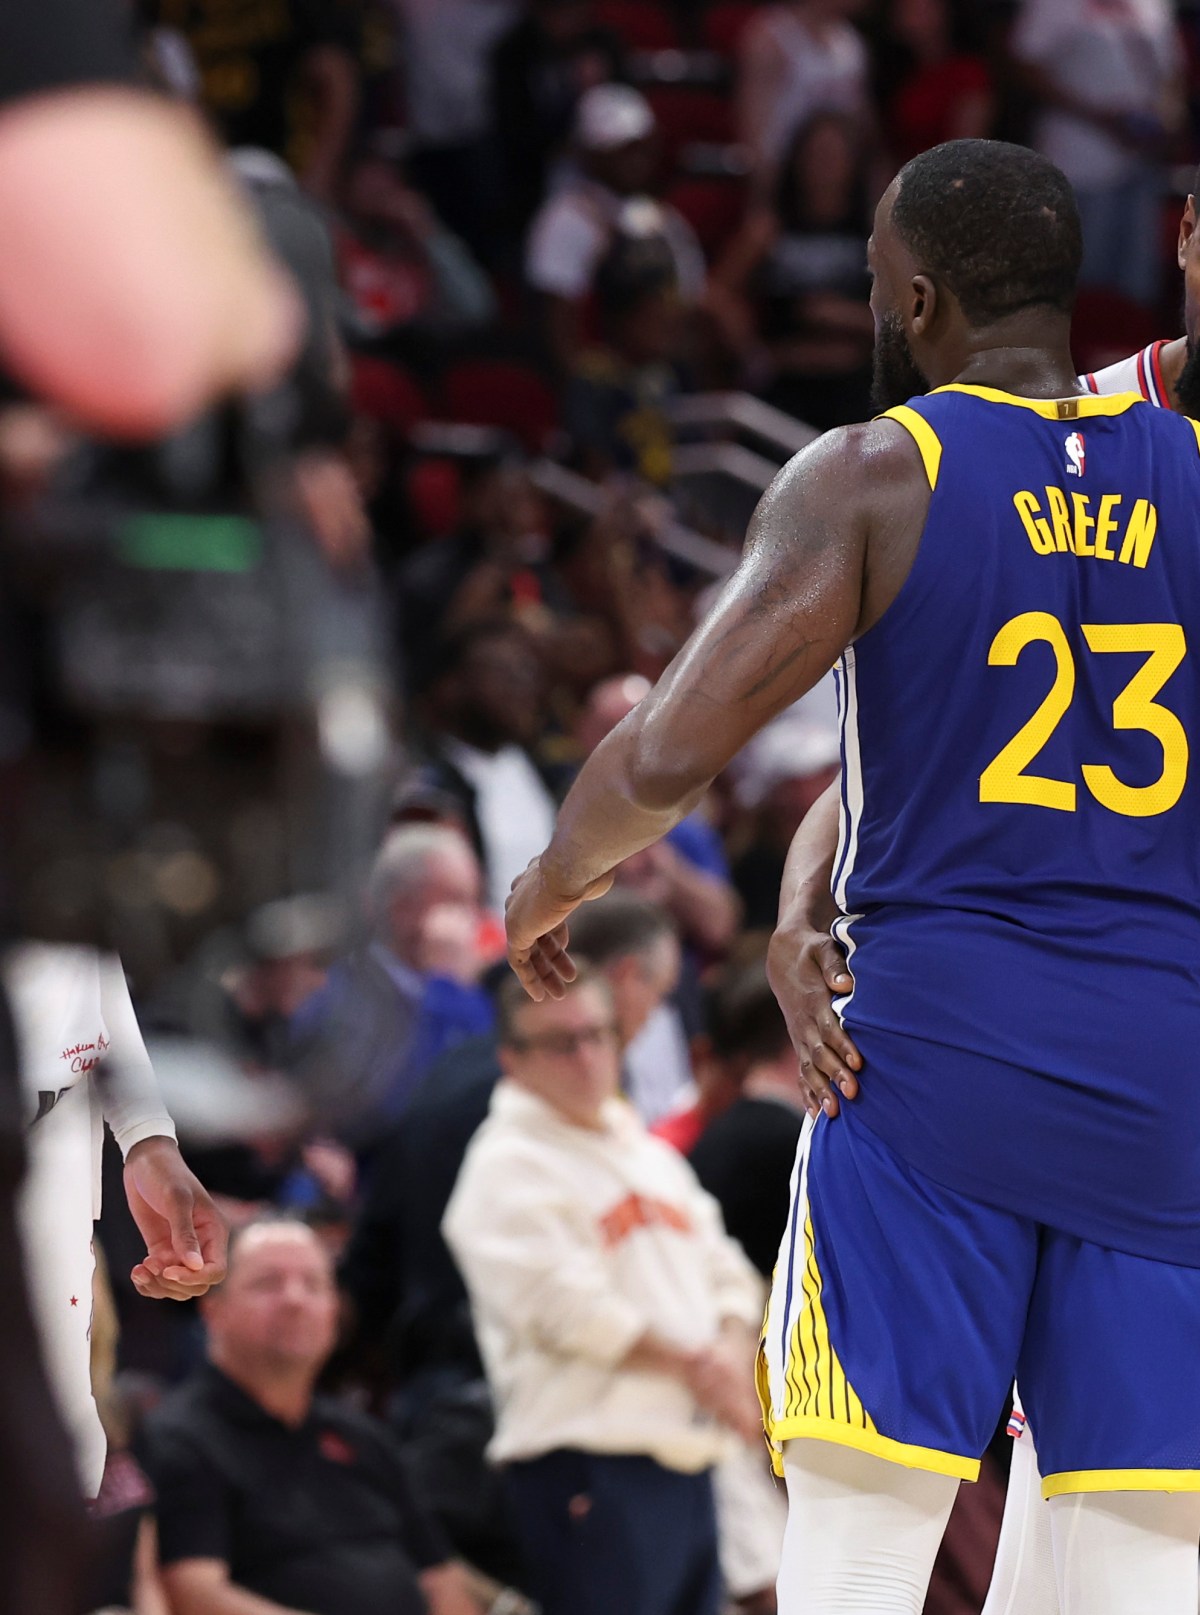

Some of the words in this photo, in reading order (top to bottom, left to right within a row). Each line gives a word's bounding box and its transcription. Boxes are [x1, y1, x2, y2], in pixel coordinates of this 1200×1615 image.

[1066, 464, 1077, 474] NBA
[1013, 486, 1157, 569] GREEN
[979, 611, 1189, 817] 23
